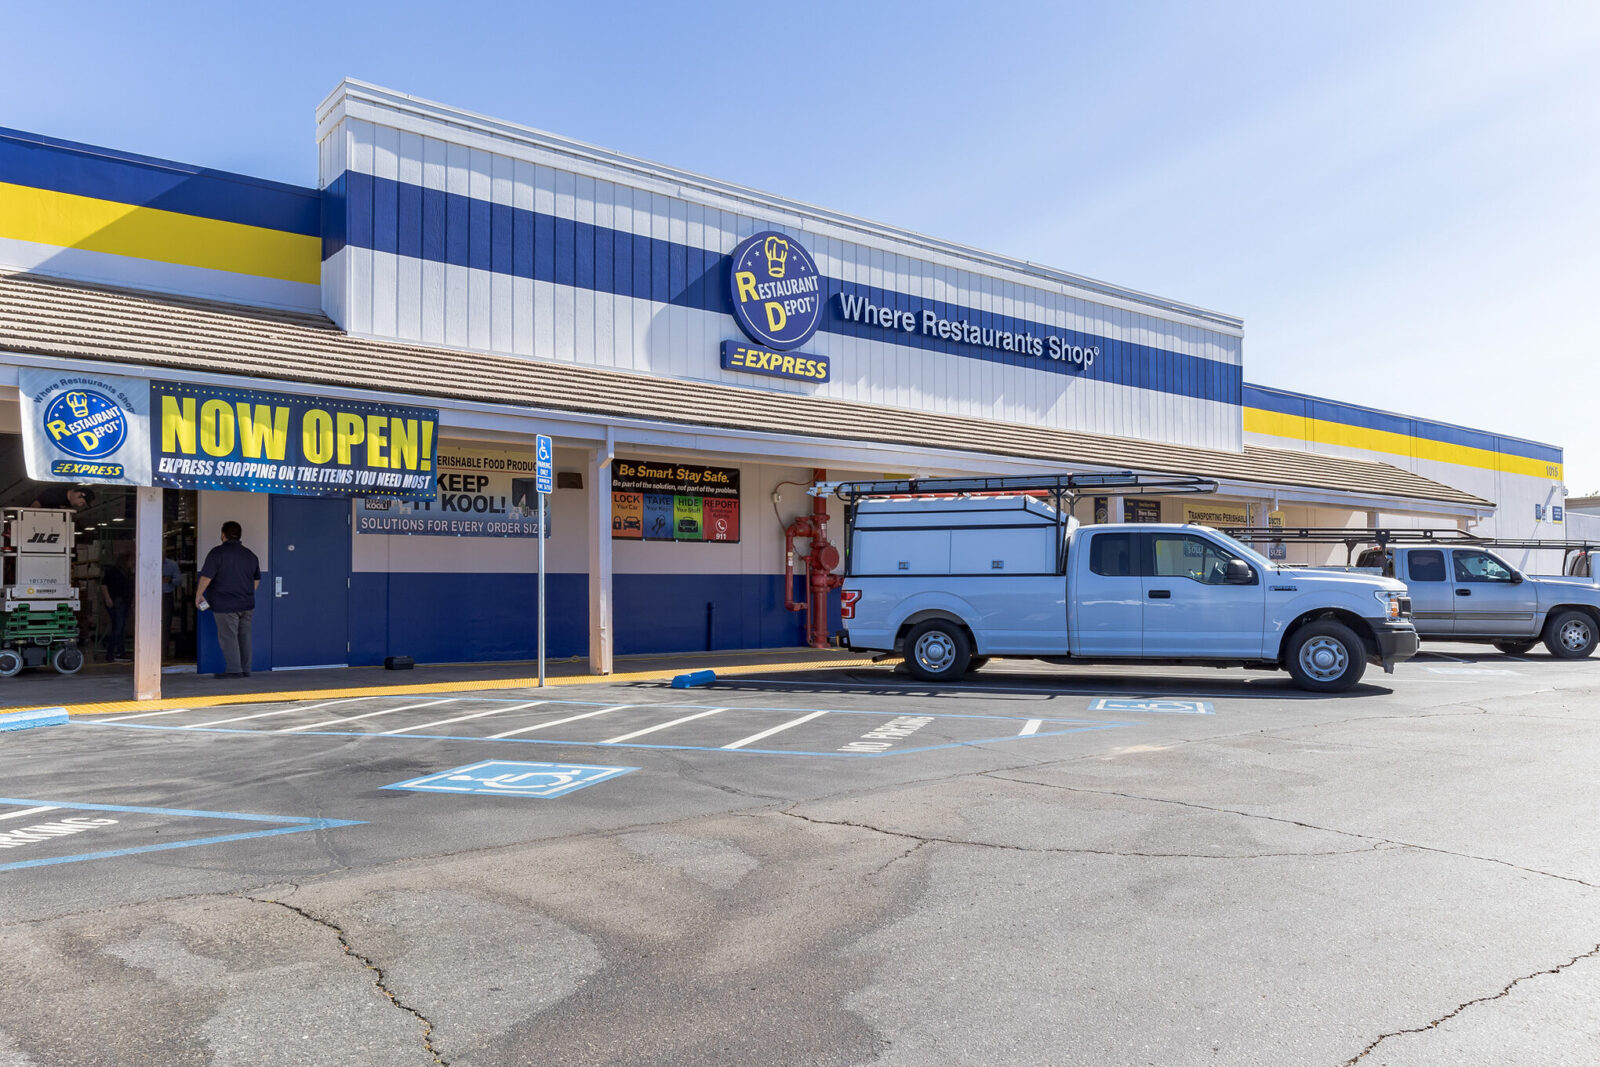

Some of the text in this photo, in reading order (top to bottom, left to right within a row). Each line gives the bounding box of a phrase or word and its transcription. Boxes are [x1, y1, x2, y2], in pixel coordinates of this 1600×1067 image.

[736, 271, 818, 302] RESTAURANT
[840, 292, 916, 332] Where
[923, 310, 1044, 356] Restaurants
[745, 350, 826, 378] EXPRESS
[34, 378, 136, 414] Where Restaurants Shop
[162, 395, 434, 472] NOW OPEN!
[62, 463, 122, 476] EXPRESS
[437, 455, 482, 470] ERISHABLE
[483, 457, 506, 470] FOOD
[158, 457, 432, 490] EXPRESS SHOPPING ON THE ITEMS YOU NEED MOST
[619, 464, 635, 476] Be
[676, 468, 702, 484] Stay
[702, 470, 730, 483] Safe.
[1546, 464, 1558, 478] 1015
[442, 493, 506, 514] KOOL!
[614, 494, 640, 504] LOCK
[647, 496, 671, 505] TAKE
[678, 498, 699, 507] HIDE
[704, 500, 738, 510] REPORT
[1188, 510, 1222, 522] TRANSPORTING
[361, 517, 425, 531] SOLUTIONS
[428, 520, 448, 532] FOR
[451, 520, 484, 532] EVERY
[487, 522, 520, 534] ORDER
[27, 532, 60, 544] JLG
[836, 742, 893, 752] NO
